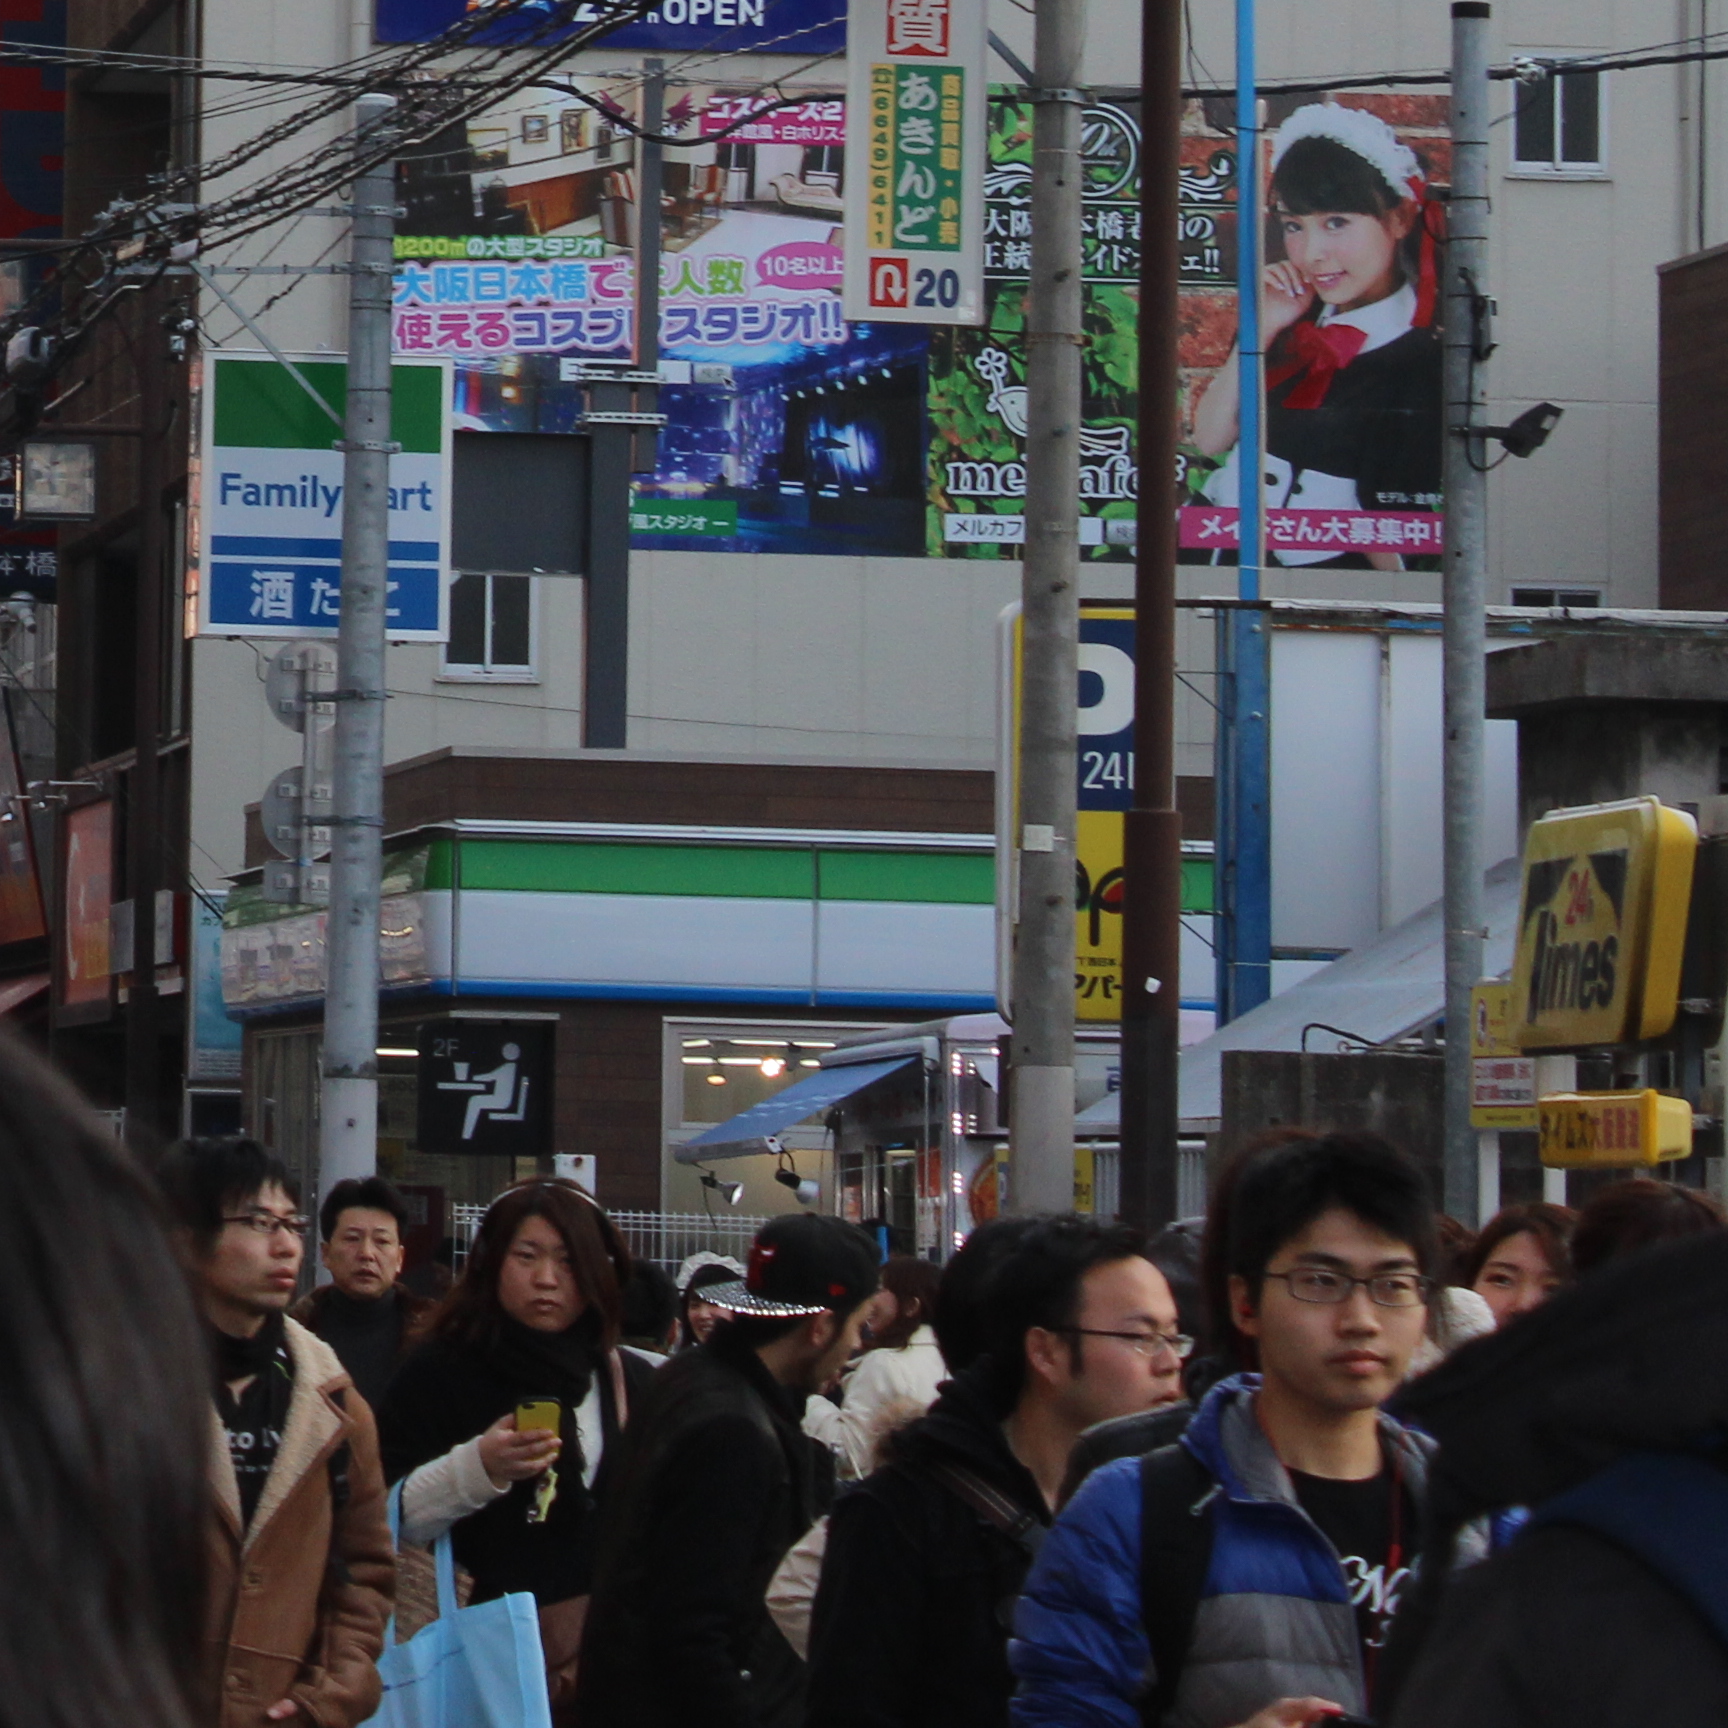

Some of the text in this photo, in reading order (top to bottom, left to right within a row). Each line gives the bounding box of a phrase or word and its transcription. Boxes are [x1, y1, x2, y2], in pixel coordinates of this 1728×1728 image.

[894, 72, 939, 244] あきんど
[760, 254, 843, 279] 10名以上
[914, 268, 960, 308] 20
[220, 471, 433, 517] Familyart
[249, 569, 295, 621] 酒
[432, 1038, 459, 1059] 2F
